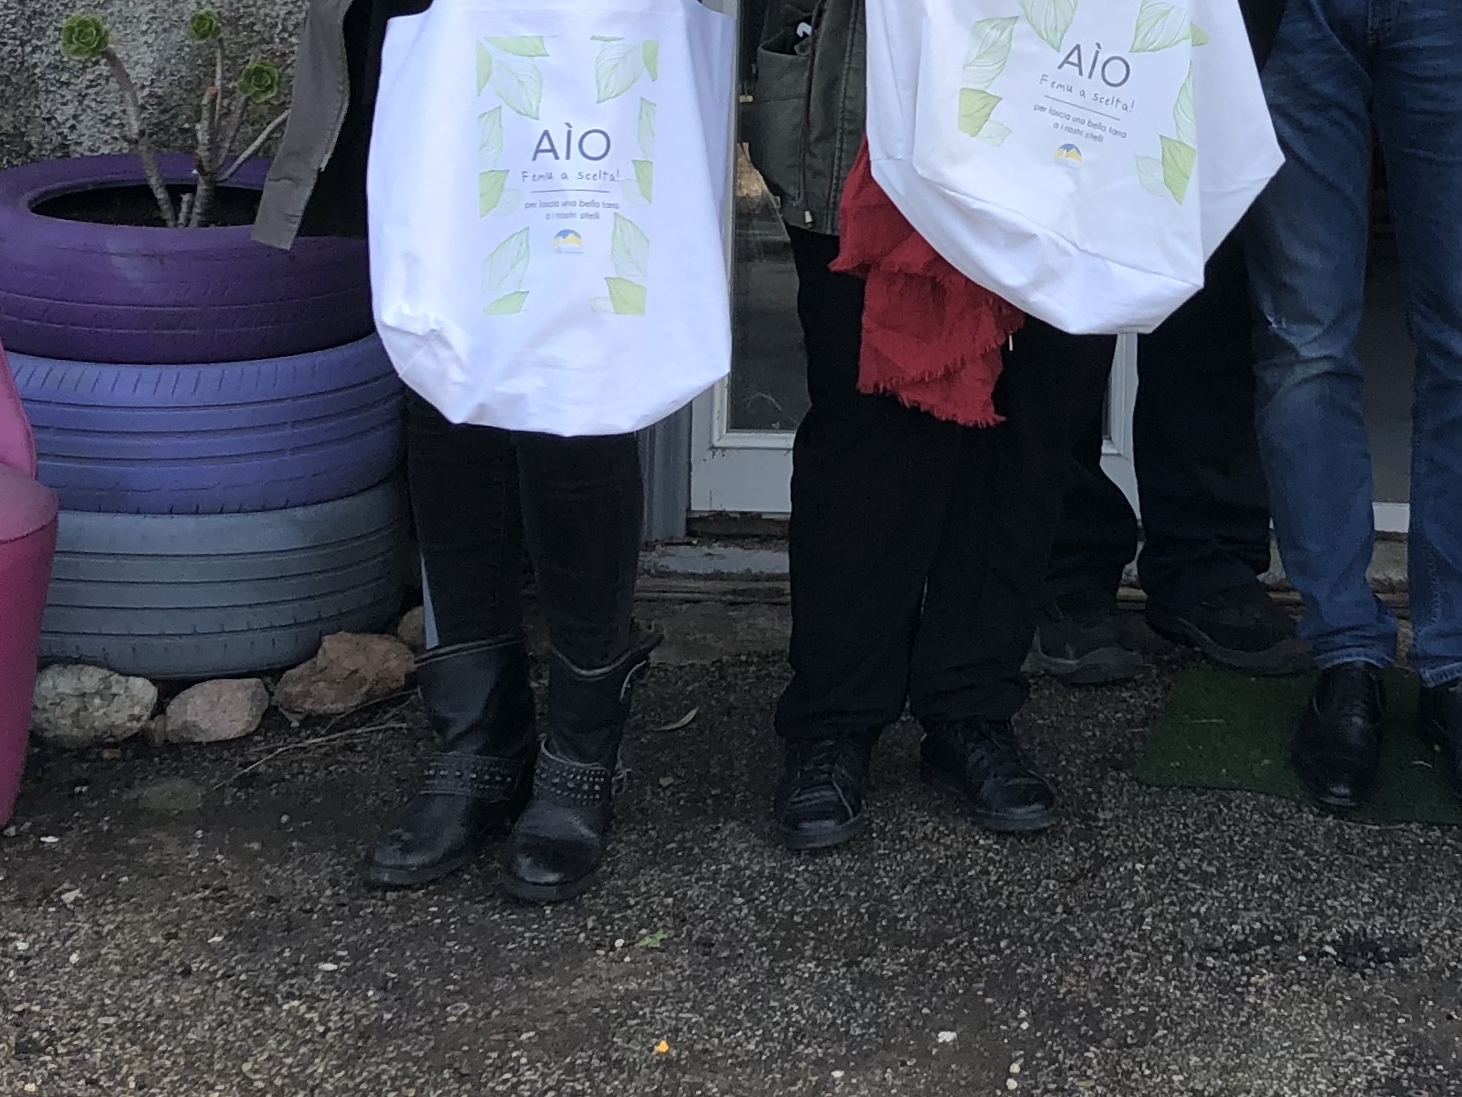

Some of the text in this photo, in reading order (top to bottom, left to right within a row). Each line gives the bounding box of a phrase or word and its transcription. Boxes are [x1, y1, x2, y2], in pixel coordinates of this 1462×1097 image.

[1057, 41, 1131, 88] AÌO
[1039, 73, 1135, 113] Femu a scelta!
[1033, 103, 1047, 113] per
[1071, 115, 1086, 125] una
[1087, 118, 1107, 132] bella
[531, 121, 611, 162] AÌO
[521, 169, 620, 183] Femu a scelta!
